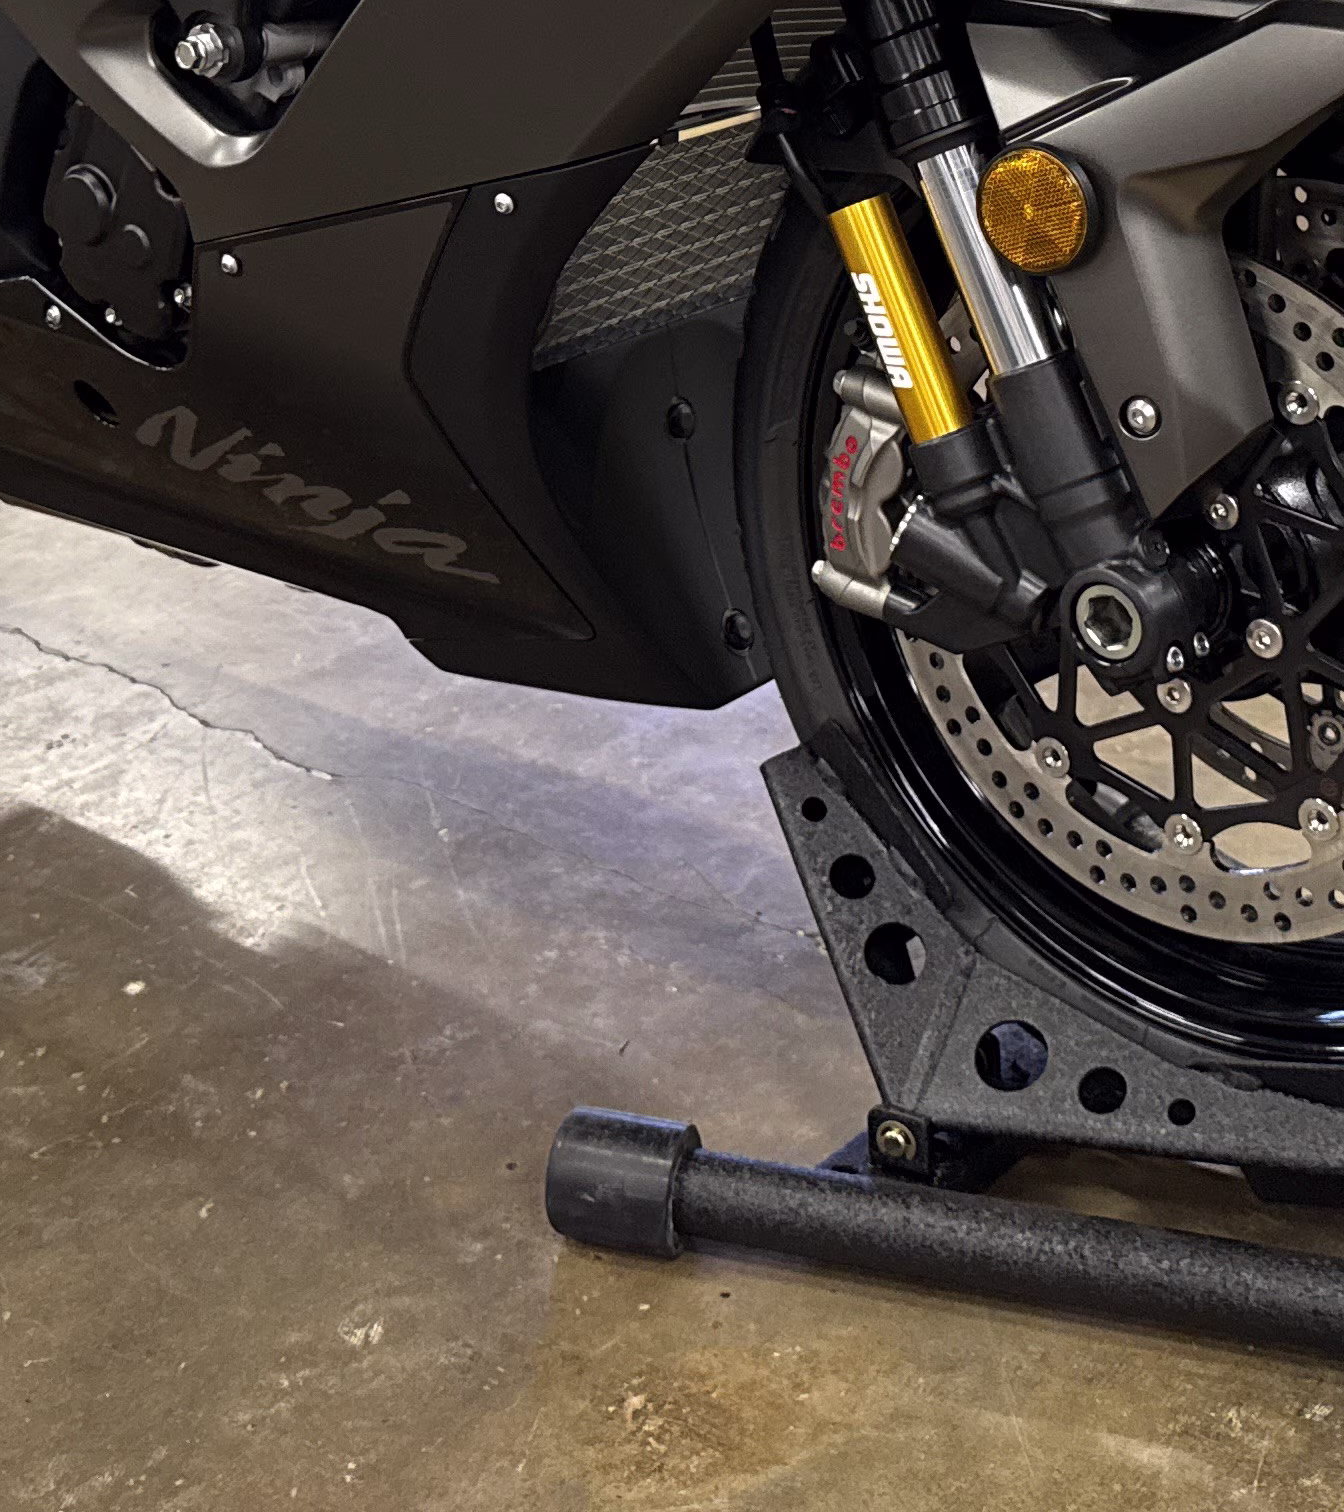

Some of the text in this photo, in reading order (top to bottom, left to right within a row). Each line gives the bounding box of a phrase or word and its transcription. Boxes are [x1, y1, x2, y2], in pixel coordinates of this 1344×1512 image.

[850, 271, 913, 389] SHOWA
[136, 405, 501, 585] Ninja
[829, 434, 859, 553] brembo
